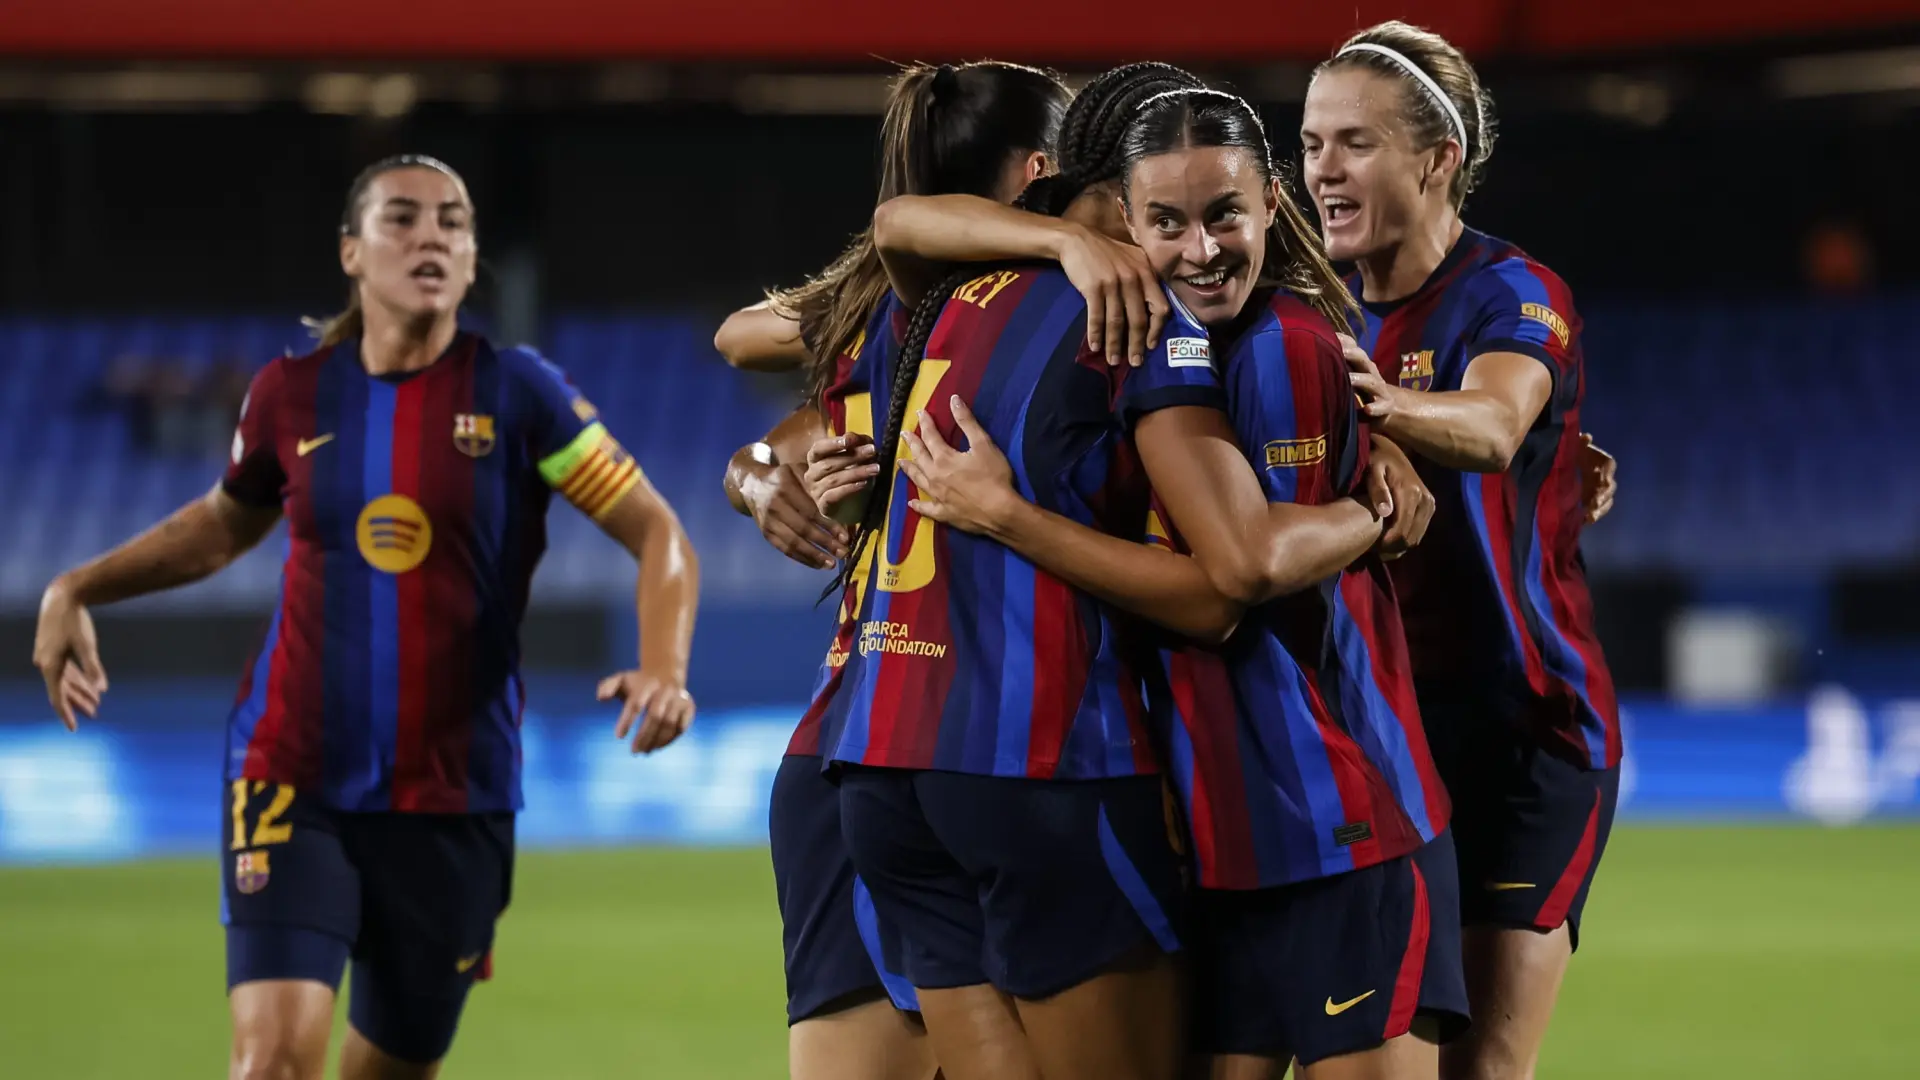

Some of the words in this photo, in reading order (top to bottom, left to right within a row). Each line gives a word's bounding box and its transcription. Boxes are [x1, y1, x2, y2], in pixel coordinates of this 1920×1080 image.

[1521, 303, 1569, 346] BIMBO
[1169, 338, 1190, 346] UEFA
[1265, 438, 1327, 465] BIMBO
[866, 620, 908, 638] ARÇA
[866, 636, 947, 658] OUNDATION
[230, 778, 296, 851] 12
